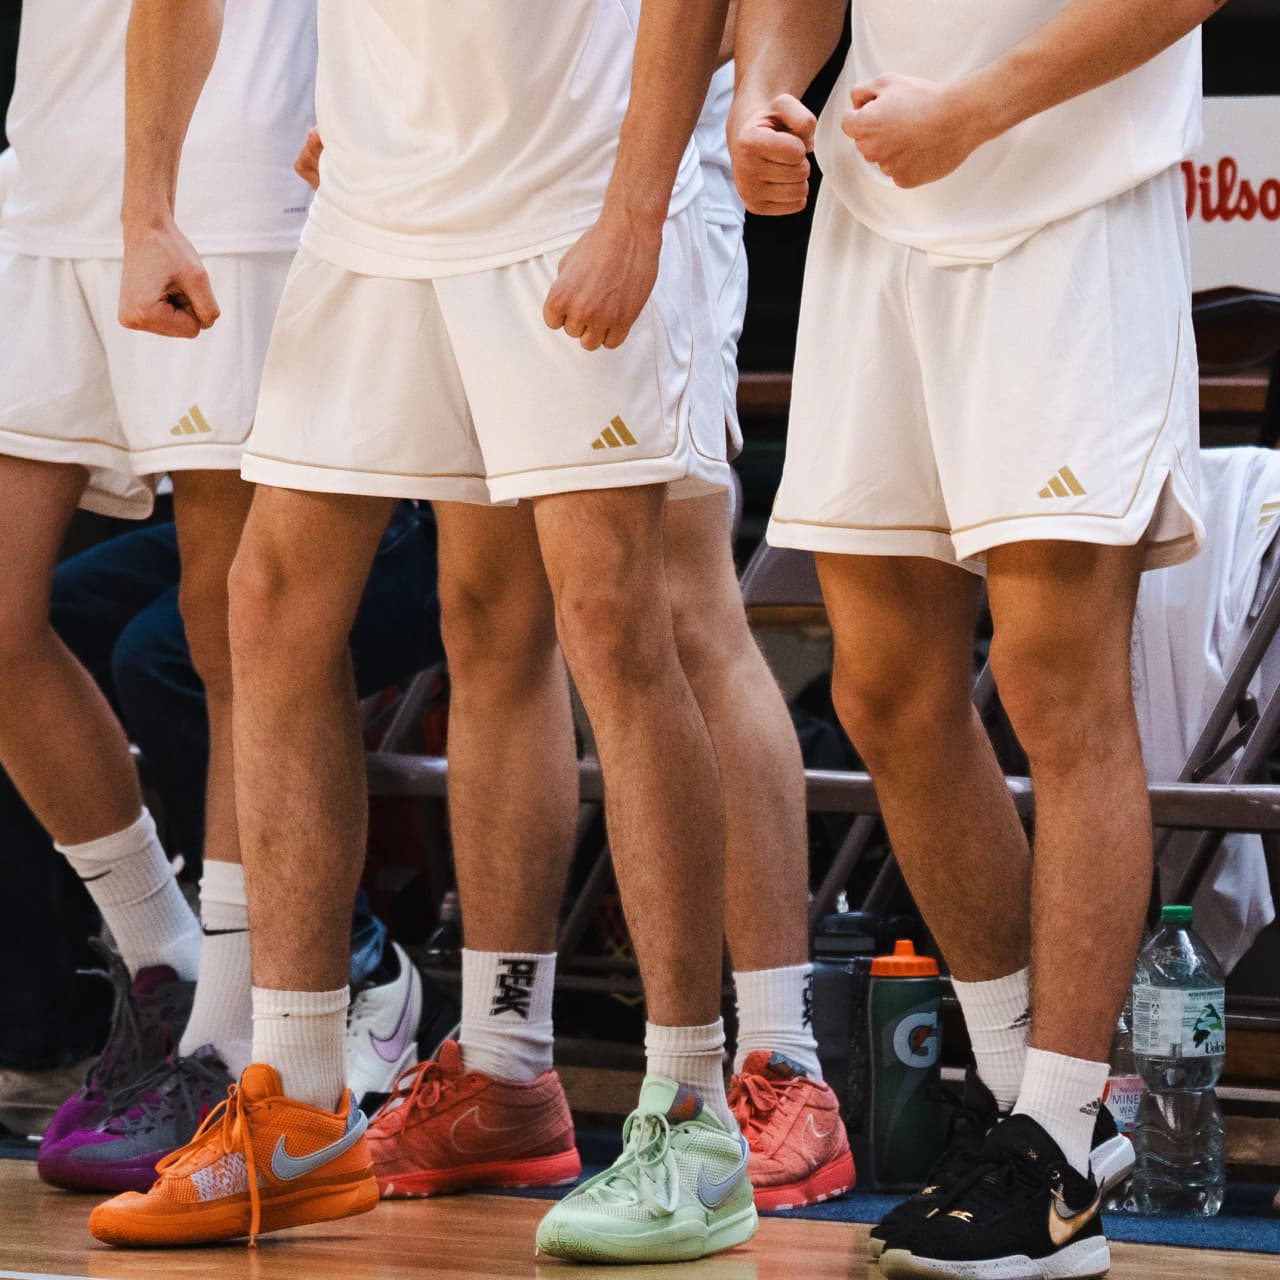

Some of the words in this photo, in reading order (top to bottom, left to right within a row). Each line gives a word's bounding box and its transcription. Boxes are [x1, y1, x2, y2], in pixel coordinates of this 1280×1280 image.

[489, 959, 539, 1021] PEAK
[893, 1010, 938, 1069] G
[1112, 1095, 1139, 1104] MINE
[1119, 1106, 1137, 1114] WAS
